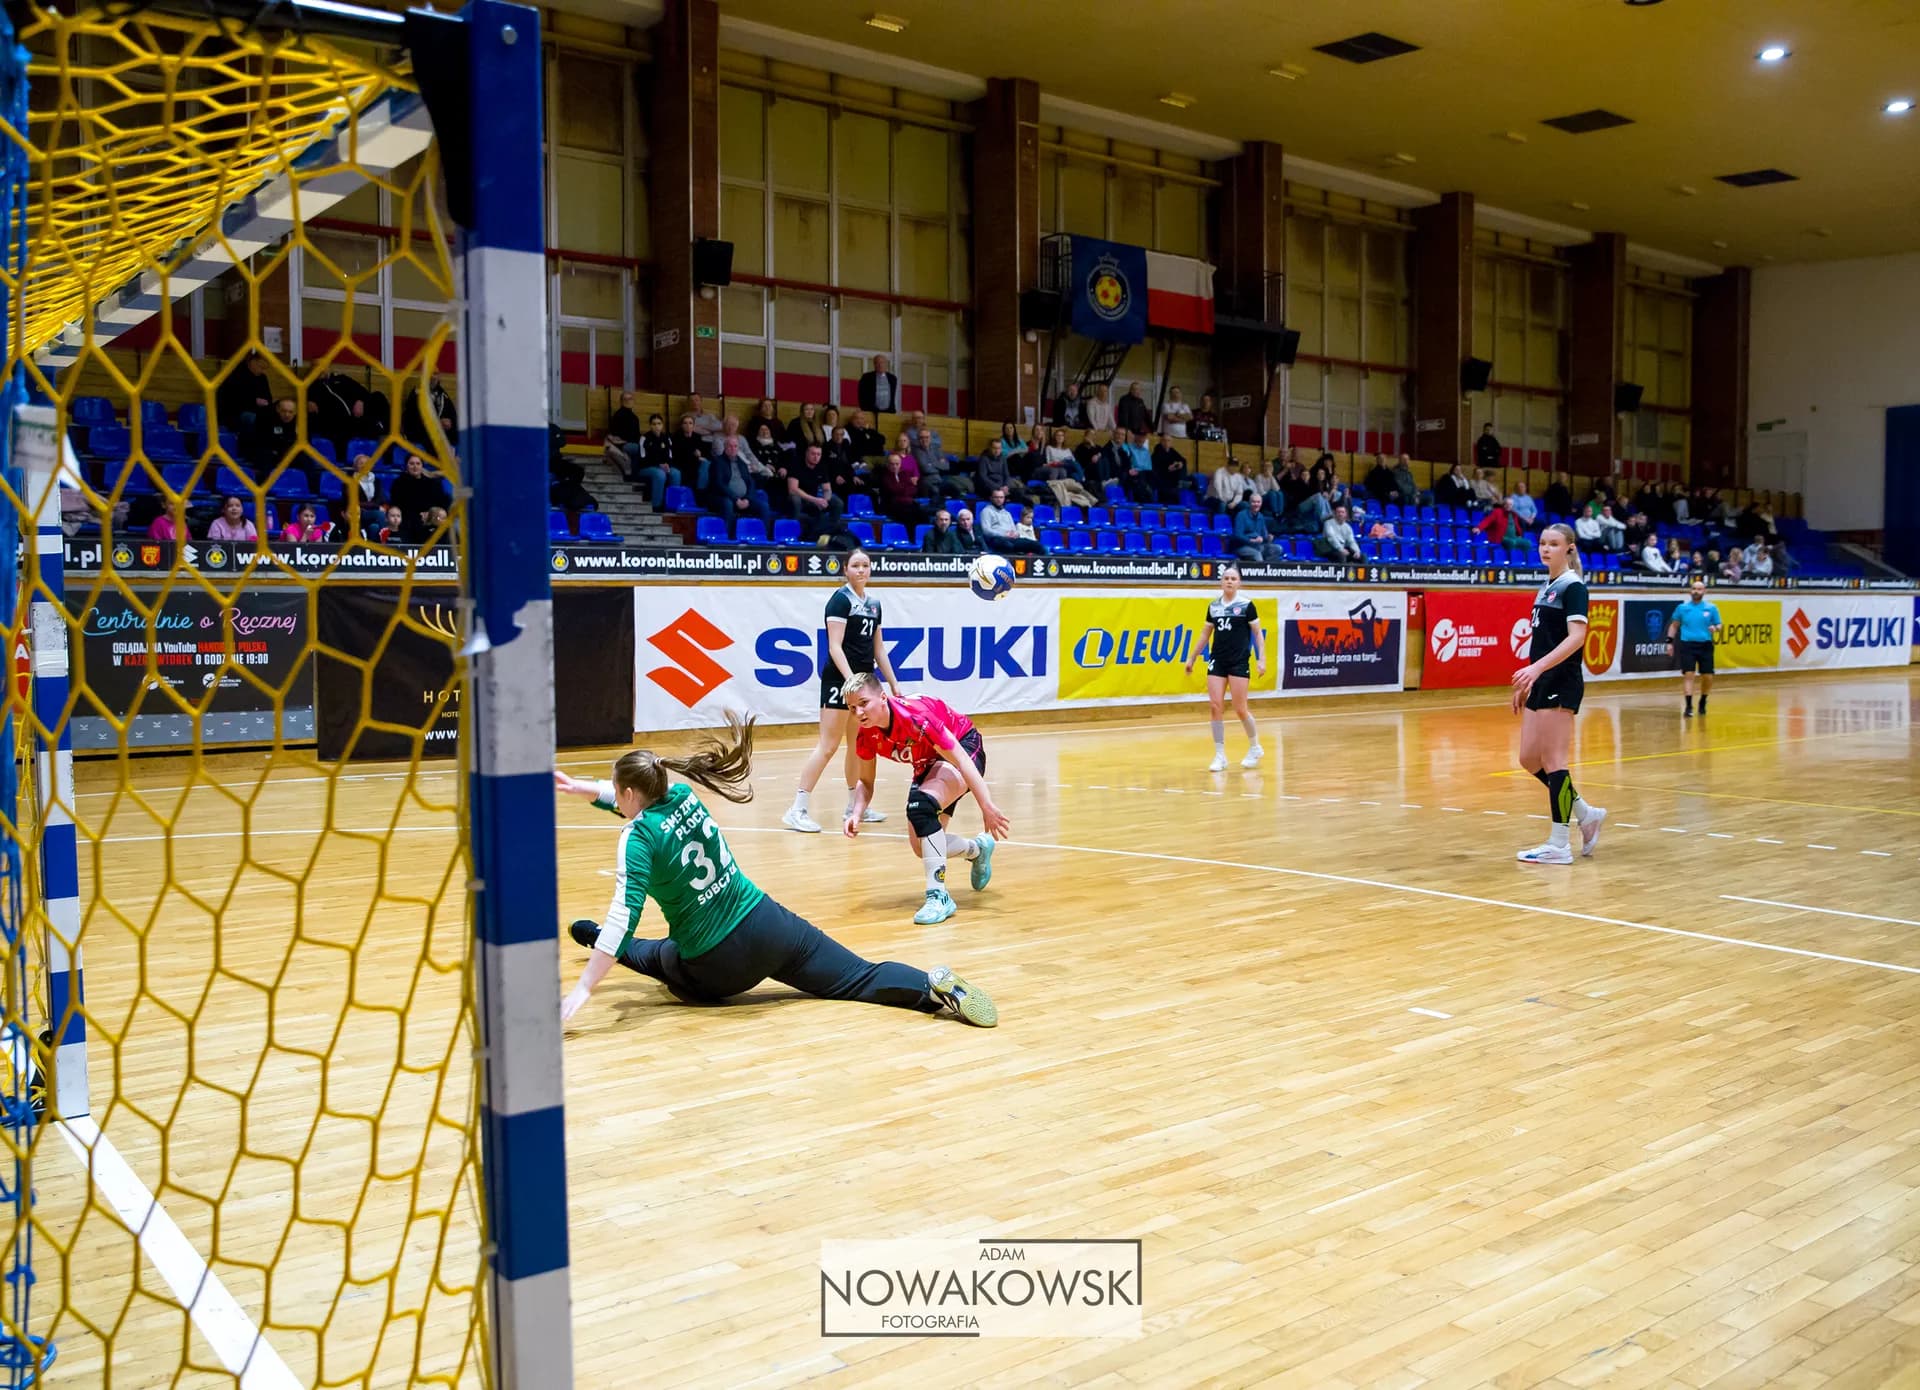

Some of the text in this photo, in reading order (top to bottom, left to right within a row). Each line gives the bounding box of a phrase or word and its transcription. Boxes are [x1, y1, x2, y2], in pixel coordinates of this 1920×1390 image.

[65, 543, 102, 568] l.pl
[236, 547, 455, 567] www.koronahandball.
[574, 551, 762, 574] www.koronahandball.pl
[1062, 561, 1188, 579] www.koronahandball.pl
[1241, 565, 1345, 582] www.koronahandball.pl
[200, 616, 214, 628] o
[219, 607, 297, 635] Ręcznej
[860, 618, 874, 636] 21
[1217, 617, 1232, 631] 34
[1713, 623, 1773, 646] OLPORTER
[1816, 616, 1905, 650] SUZUKI
[163, 641, 197, 653] YouTube
[754, 626, 1048, 688] SZUKI
[112, 655, 122, 666] W
[204, 653, 244, 665] GODZNIE
[246, 653, 269, 665] 19:00
[423, 690, 461, 703] HOT
[424, 730, 460, 740] www.
[660, 808, 684, 834] SMS
[674, 805, 709, 841] PŁOCK
